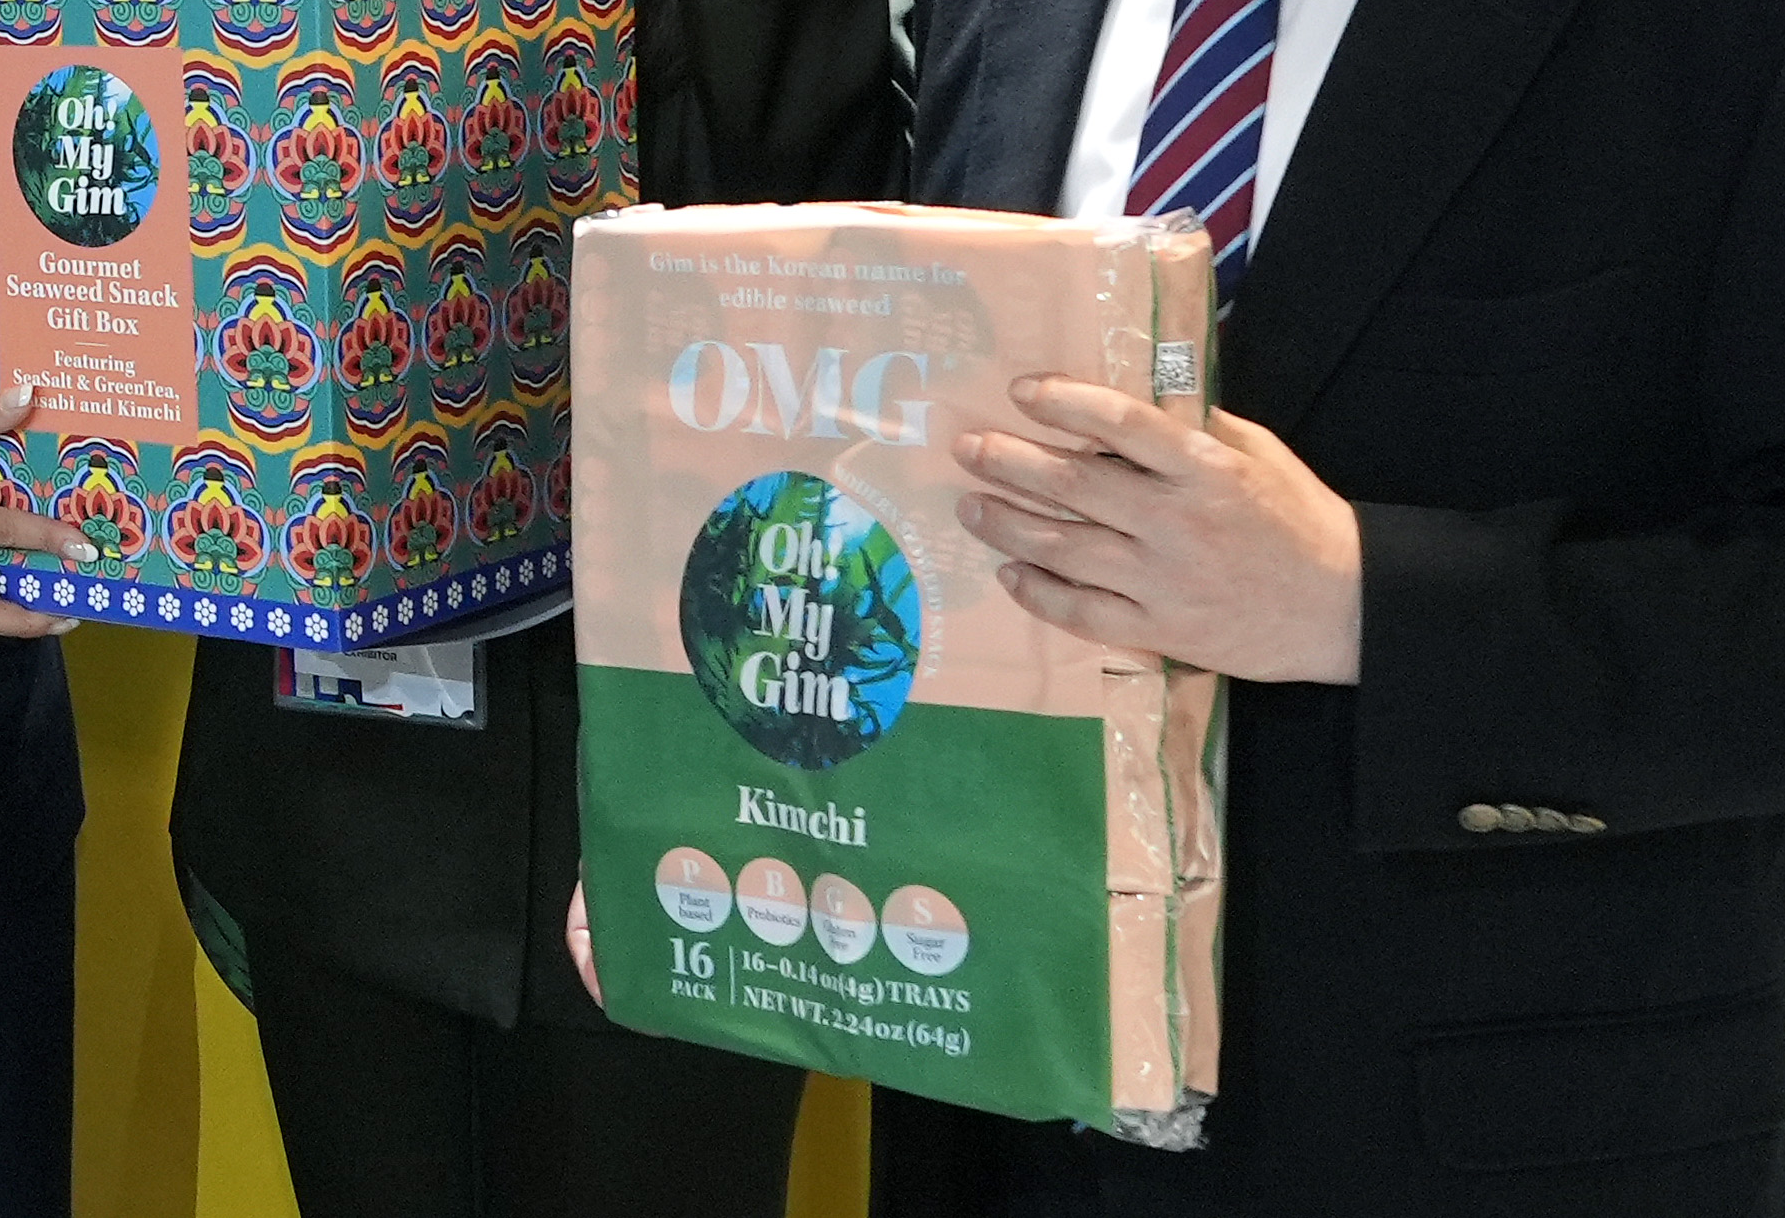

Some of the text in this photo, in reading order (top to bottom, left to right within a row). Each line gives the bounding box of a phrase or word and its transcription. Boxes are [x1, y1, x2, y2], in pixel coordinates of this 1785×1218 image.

[57, 96, 116, 132] Oh!
[55, 135, 114, 180] My
[48, 177, 127, 217] Gim
[39, 252, 142, 280] Gourmet
[650, 252, 925, 282] Gim is the Korean name
[6, 276, 179, 308] Seaweed Snack
[719, 287, 892, 316] edible seaweed
[47, 306, 139, 336] Gift Box
[54, 350, 136, 377] Featuring
[13, 368, 180, 401] SeaSalt & GreenTea,
[669, 340, 934, 447] OMG
[30, 394, 182, 422] sabi and Kimchi
[759, 521, 843, 580] Oh!
[753, 583, 834, 661] My
[740, 651, 852, 721] Gim
[736, 784, 866, 847] Kimchi
[670, 937, 714, 979] 16
[671, 979, 716, 1001] PACK
